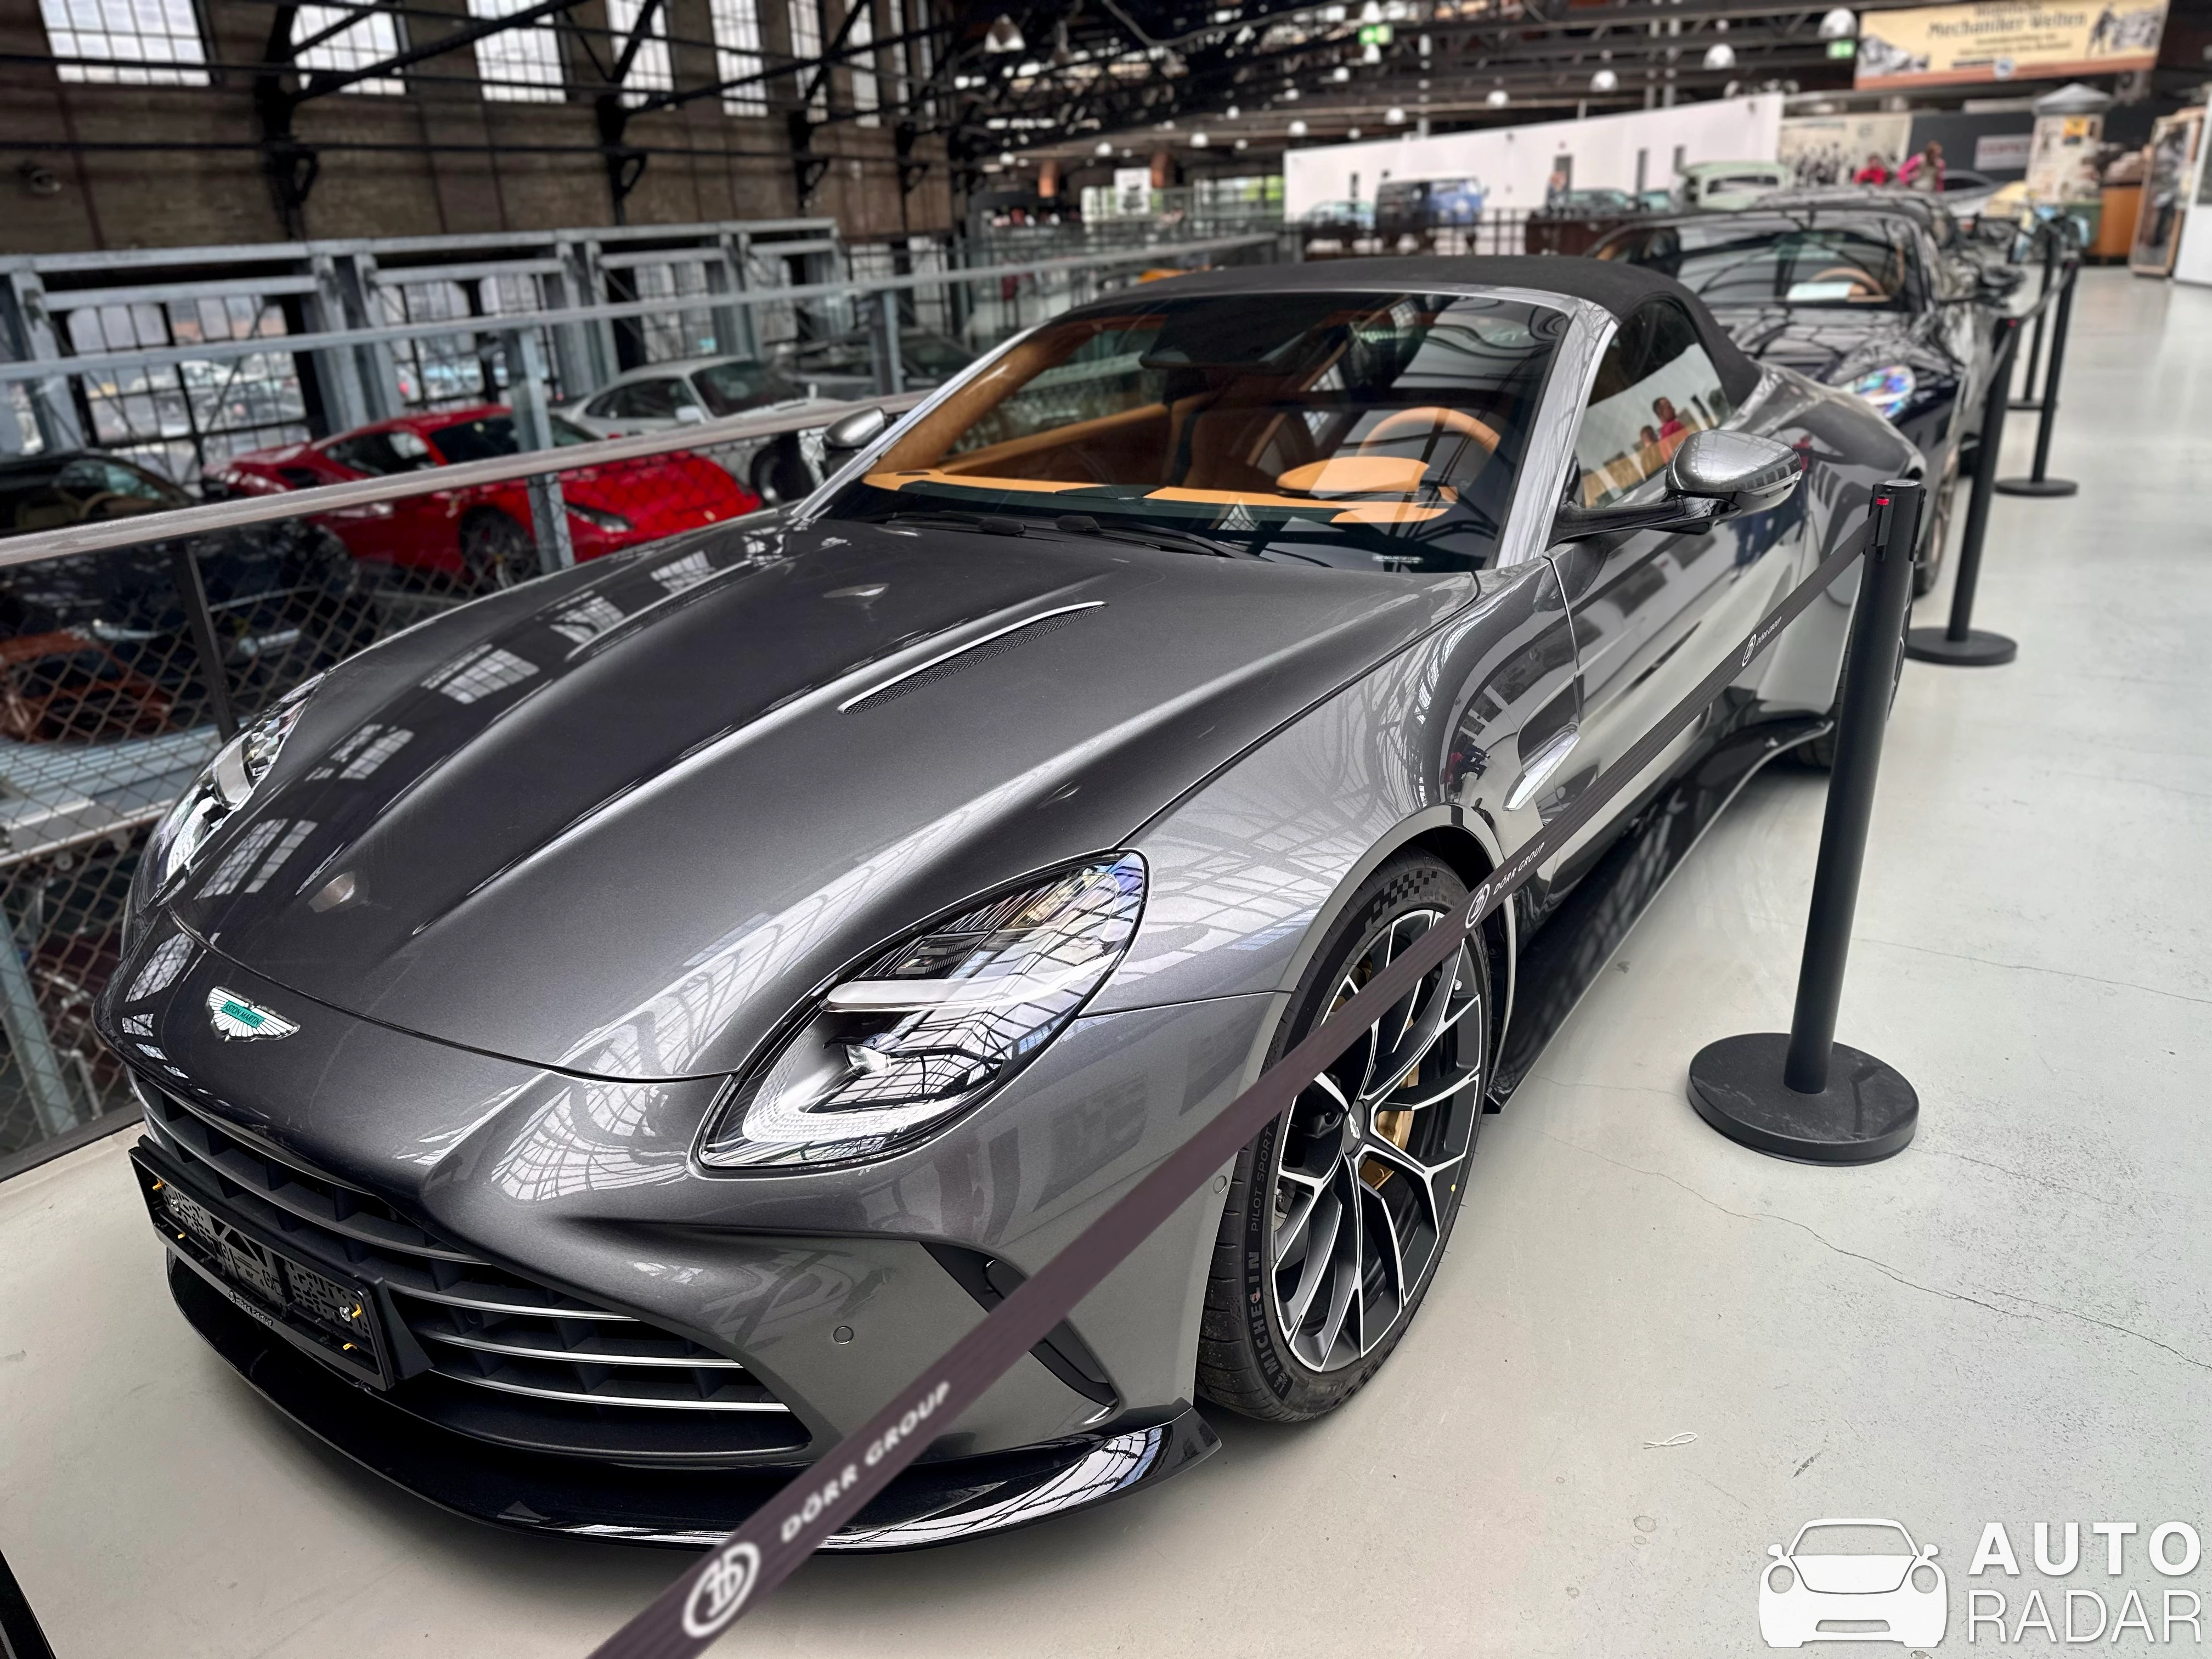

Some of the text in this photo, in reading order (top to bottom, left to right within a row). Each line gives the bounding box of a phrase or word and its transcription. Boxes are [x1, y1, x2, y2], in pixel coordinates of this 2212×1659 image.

[1493, 841, 1545, 895] DÖRR GROUP
[224, 1003, 262, 1026] ASTON MARTIN
[1251, 1127, 1273, 1232] PILOT SPORT
[1248, 1251, 1280, 1374] MICHELIN
[781, 1380, 951, 1544] DÖRR GROUP
